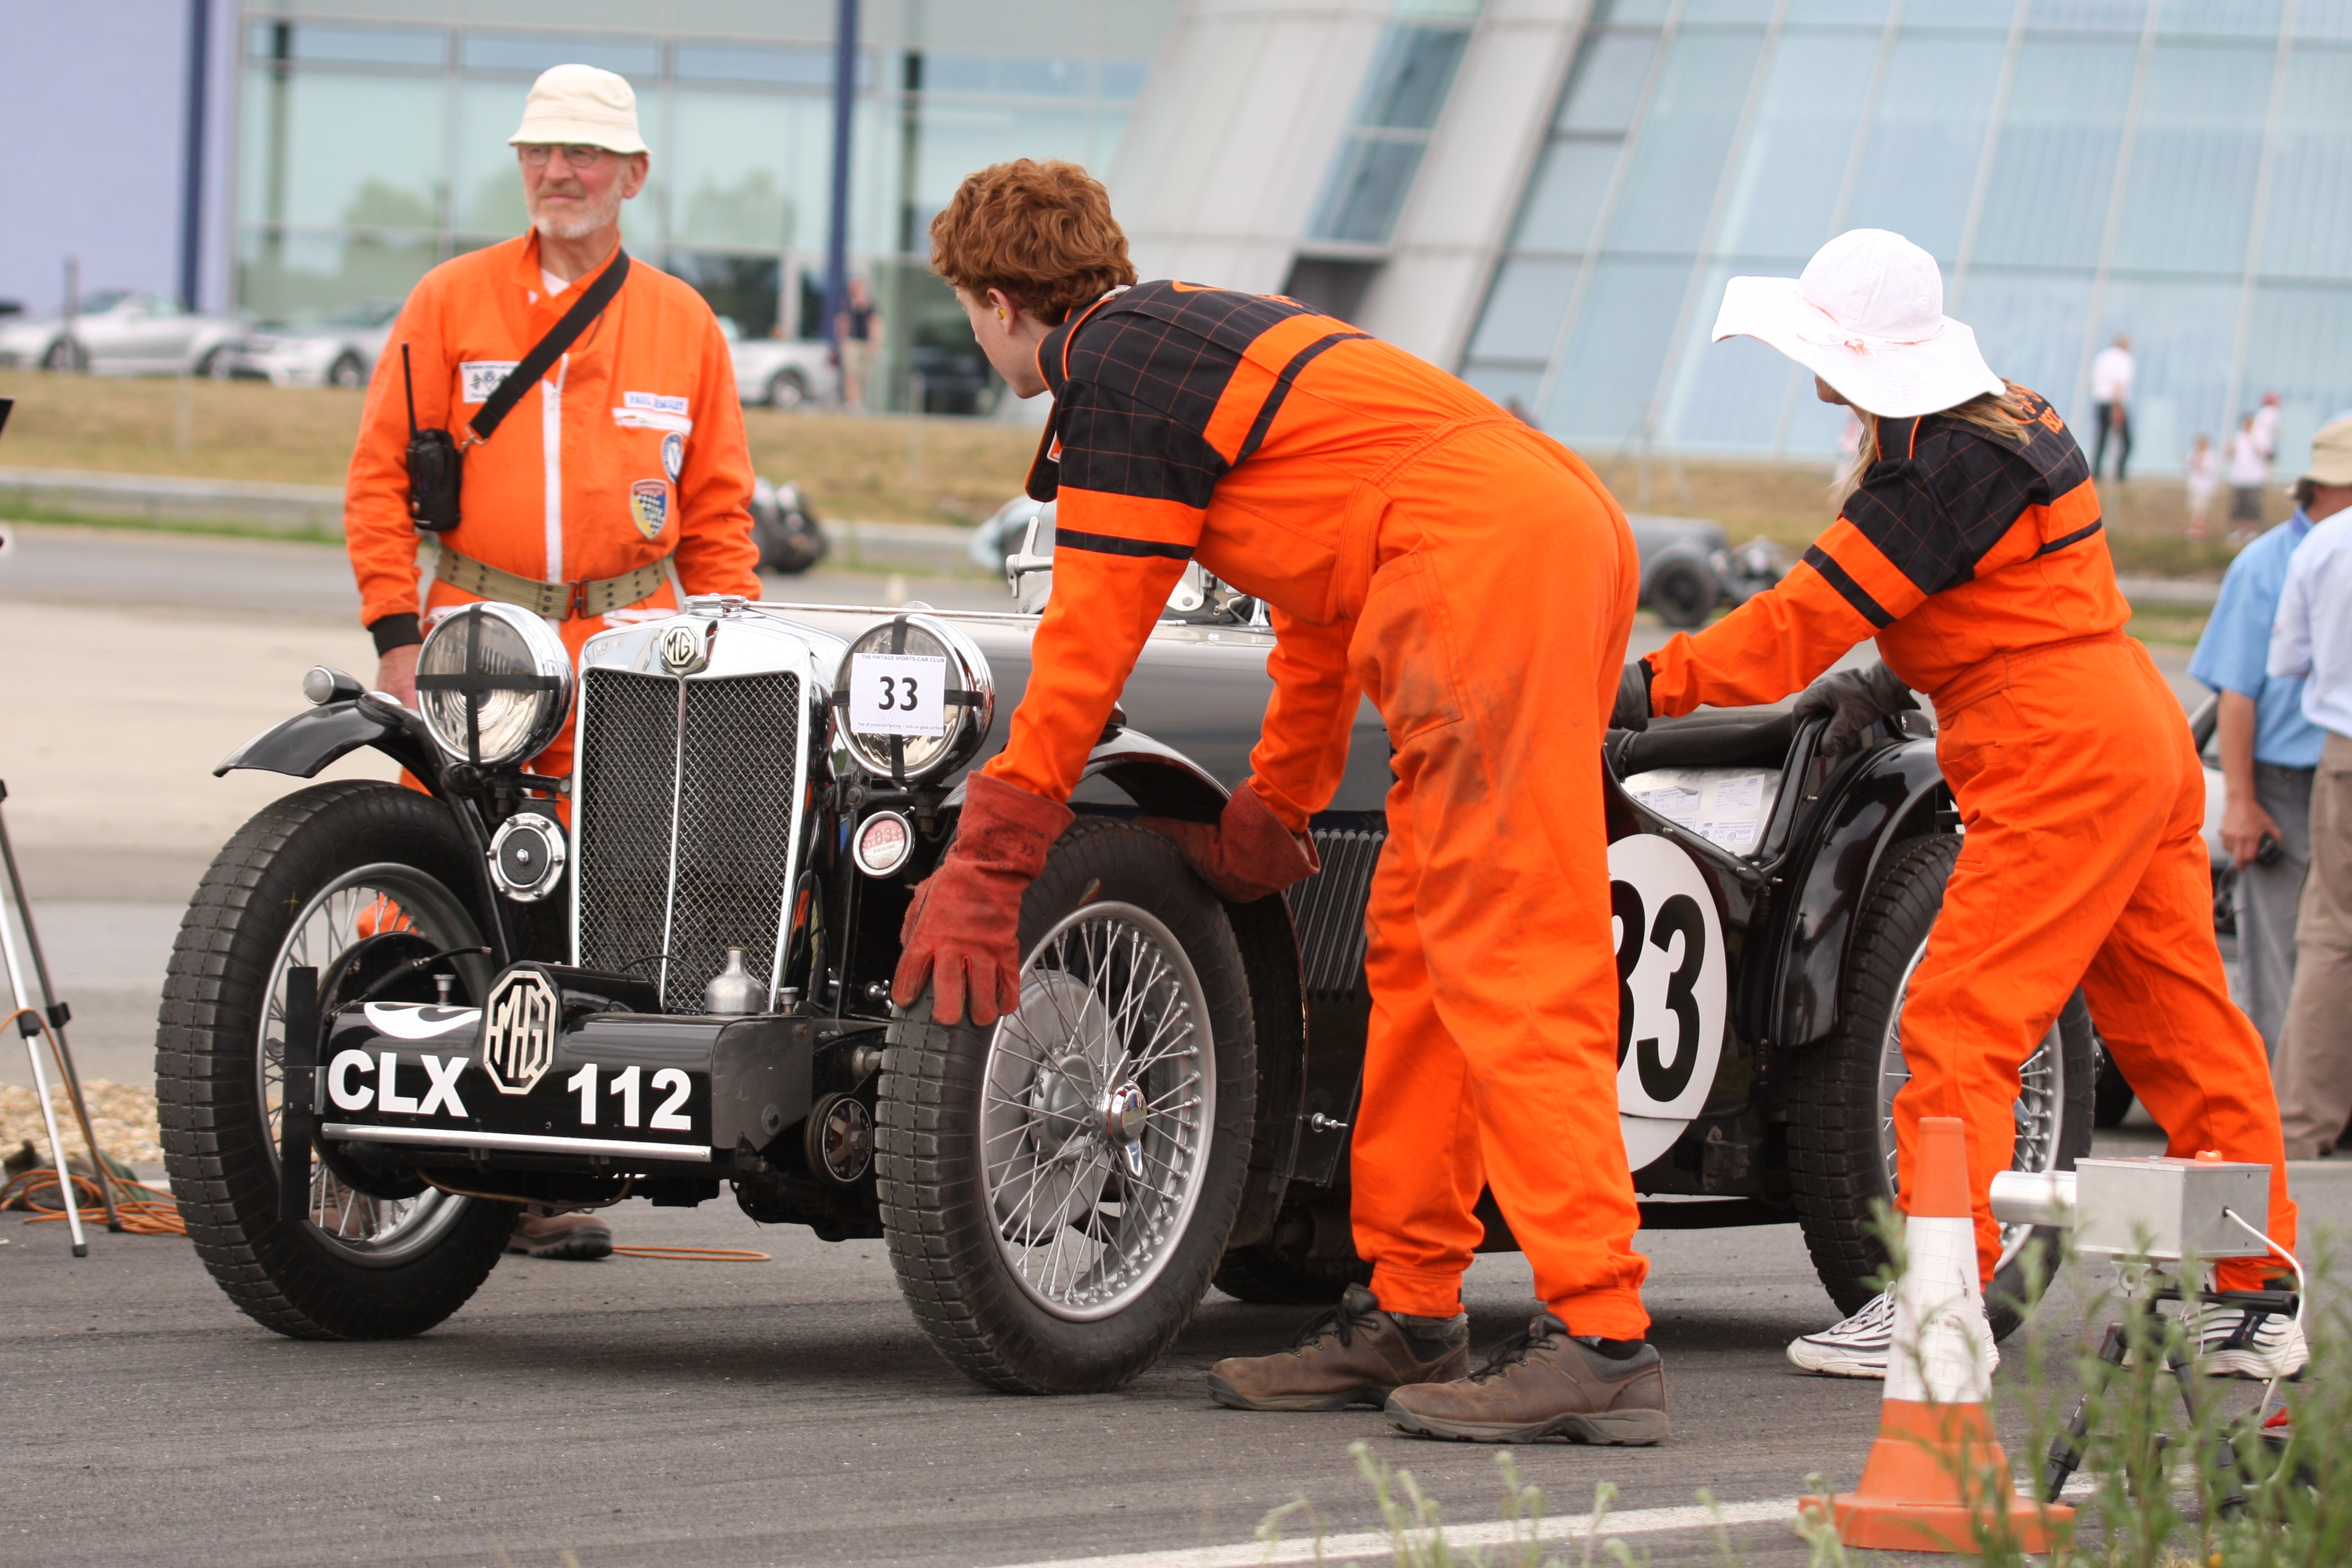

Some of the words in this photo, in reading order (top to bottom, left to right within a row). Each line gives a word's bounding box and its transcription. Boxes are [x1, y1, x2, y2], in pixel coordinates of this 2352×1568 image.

[878, 676, 918, 711] 33
[486, 979, 552, 1086] MG
[327, 1048, 470, 1117] CLX
[567, 1062, 692, 1130] 112
